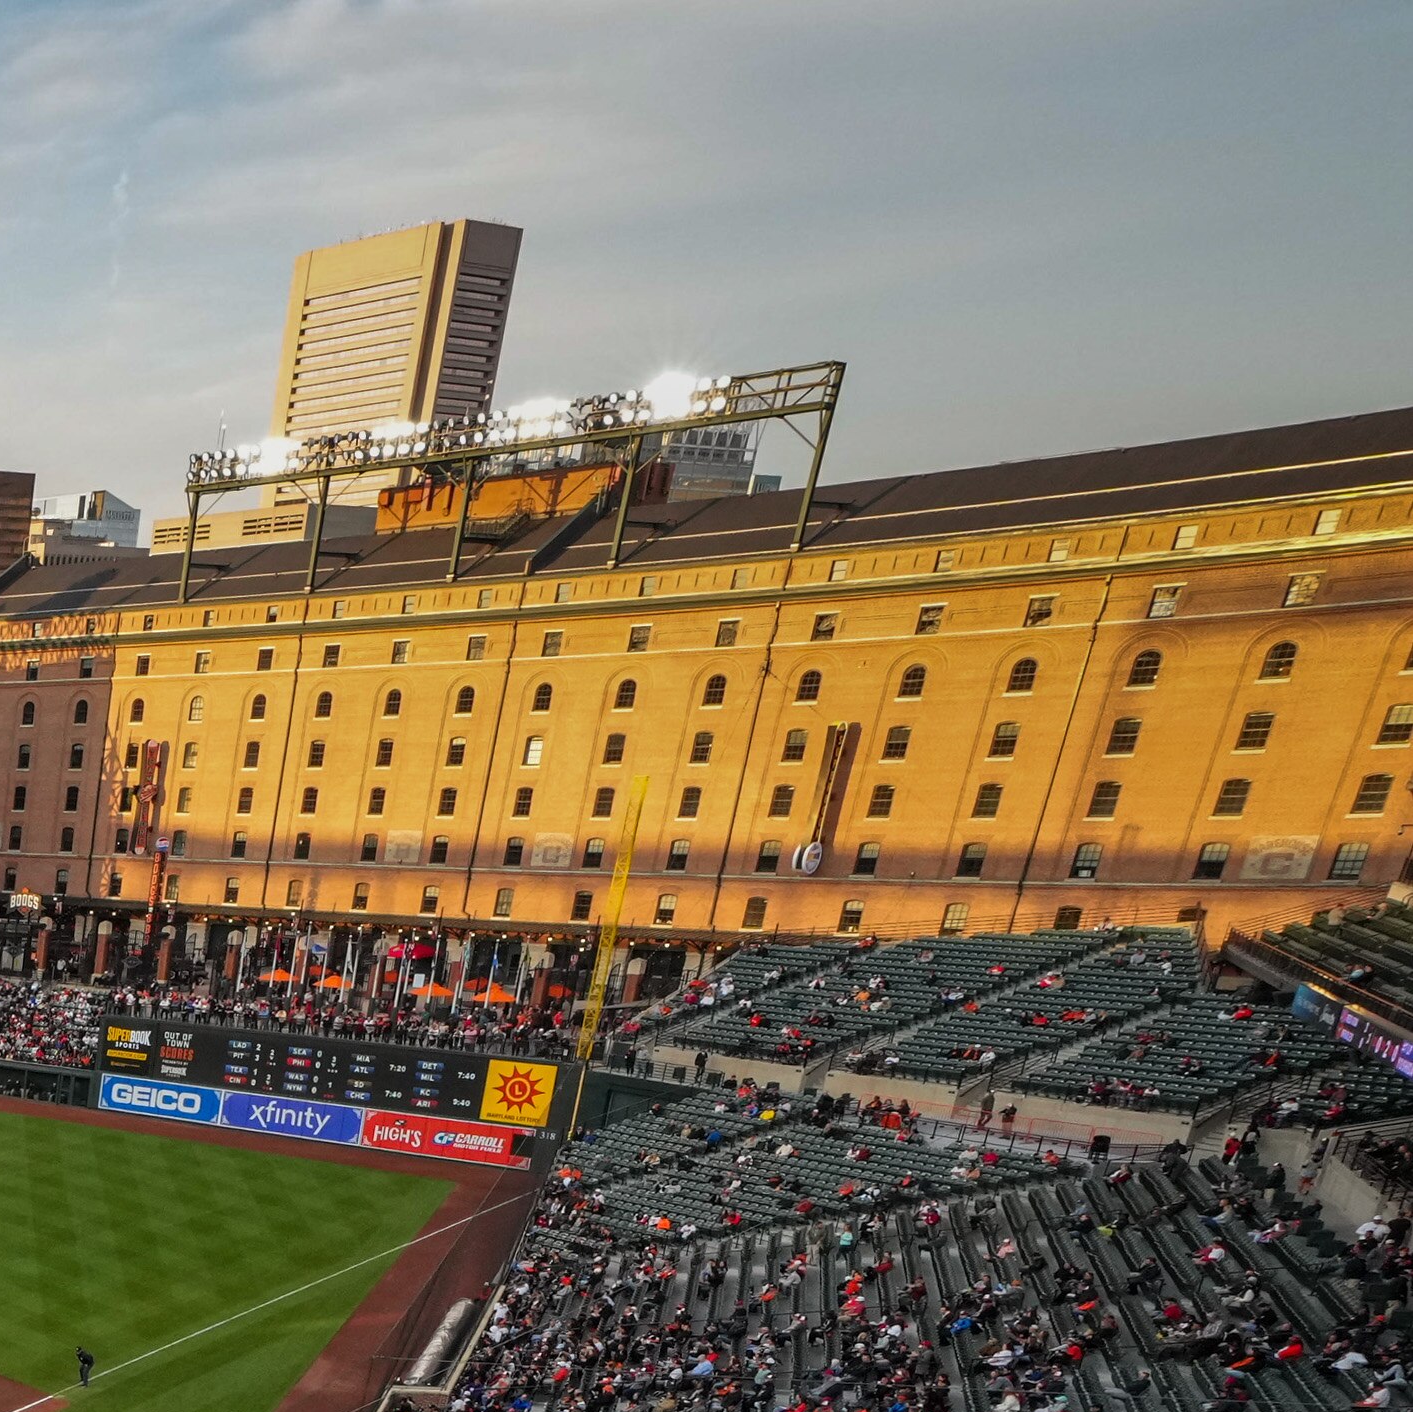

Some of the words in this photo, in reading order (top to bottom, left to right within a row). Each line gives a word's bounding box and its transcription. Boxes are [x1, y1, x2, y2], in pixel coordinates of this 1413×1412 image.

[107, 1026, 152, 1046] SUPERBOOK
[164, 1031, 180, 1039] OUT
[182, 1033, 193, 1041] OF
[115, 1041, 140, 1050] SPORTS
[166, 1039, 190, 1048] TOWN
[159, 1046, 195, 1061] SCORES
[354, 1066, 369, 1074] ATL
[389, 1063, 407, 1072] 7:20
[422, 1062, 438, 1070] DET
[229, 1076, 241, 1084] CIN
[288, 1073, 304, 1081] WAS
[457, 1071, 476, 1080] 7:40
[111, 1083, 201, 1114] GEICO
[350, 1091, 365, 1099] CHC
[385, 1090, 402, 1099] 7:40
[248, 1100, 331, 1136] xfinity
[373, 1124, 422, 1148] HIGH'S
[539, 1131, 556, 1140] 318
[454, 1133, 505, 1148] CARROLL
[452, 1143, 480, 1151] MOTOR
[481, 1146, 502, 1154] FUELS
